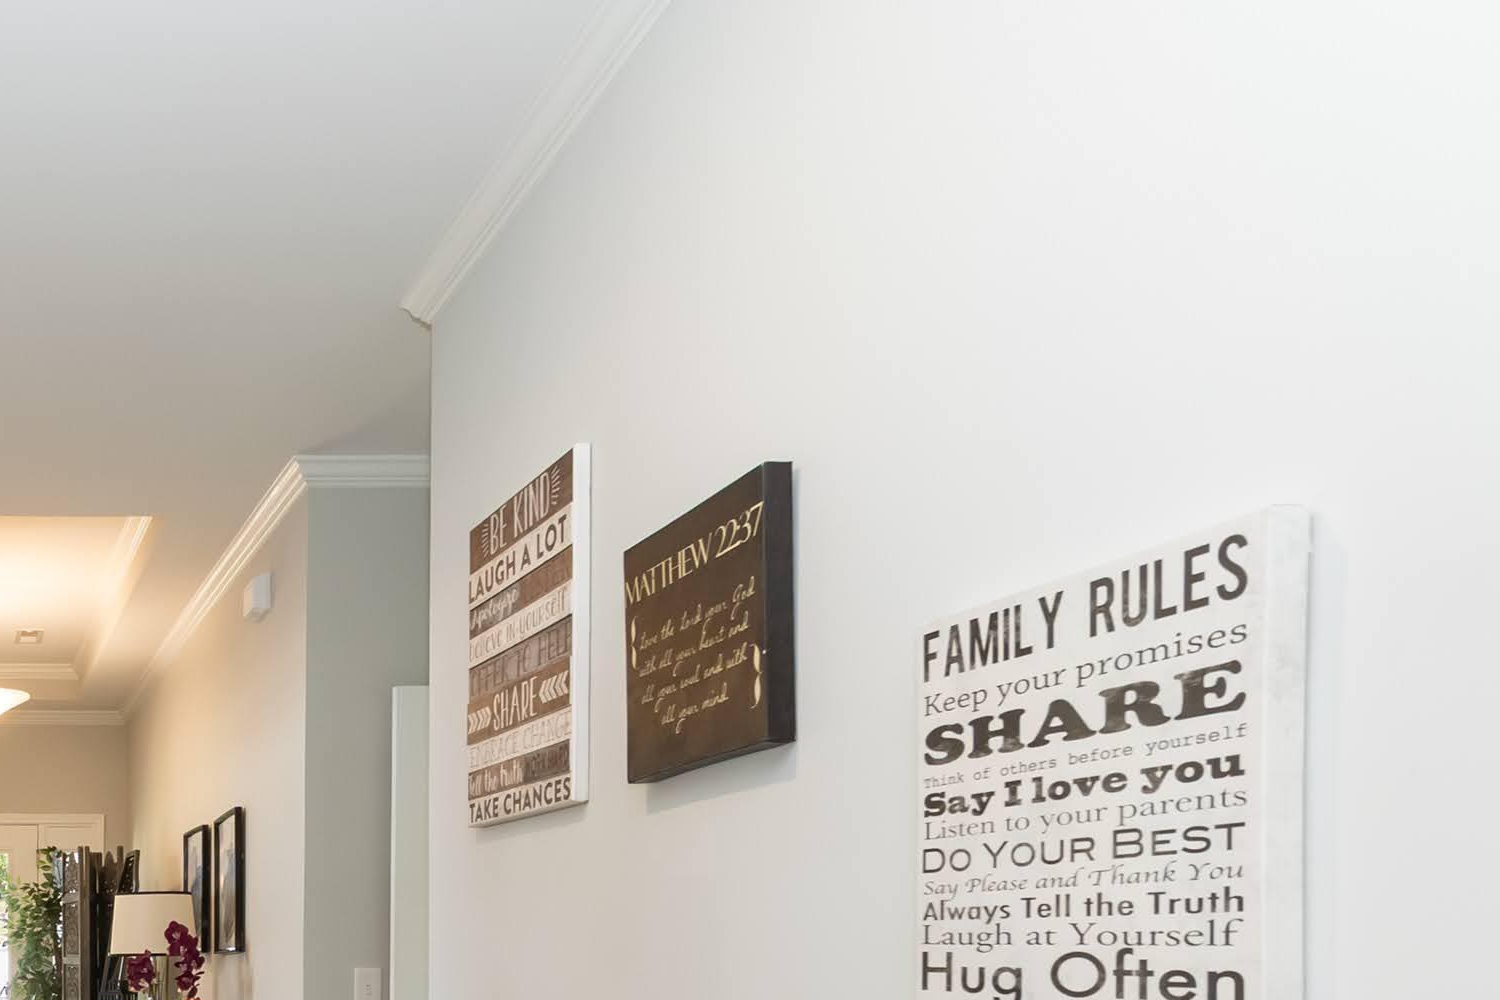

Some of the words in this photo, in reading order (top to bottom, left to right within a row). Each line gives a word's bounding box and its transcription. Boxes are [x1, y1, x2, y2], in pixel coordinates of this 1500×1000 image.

[490, 504, 507, 555] BE
[513, 472, 550, 538] KIND
[469, 551, 515, 603] LAUGH
[521, 544, 531, 570] A
[536, 514, 567, 560] LOT
[626, 532, 713, 604] MATTHEW
[923, 591, 1064, 683] FAMILY
[1089, 534, 1248, 637] RULES
[924, 685, 988, 716] Keep
[997, 669, 1065, 706] your
[1076, 623, 1248, 688] promises
[493, 676, 538, 731] SHARE
[924, 660, 1247, 766] SHARE
[924, 772, 964, 789] Think
[973, 768, 990, 780] of
[1000, 758, 1057, 776] others
[1069, 744, 1133, 766] before
[1145, 723, 1248, 756] yourself
[924, 791, 995, 817] Say
[1004, 780, 1022, 807] I
[1031, 771, 1128, 804] love
[1140, 754, 1245, 794] you
[470, 797, 499, 823] TAKE
[504, 777, 571, 815] CHANCES
[924, 820, 995, 840] Listen
[1005, 813, 1031, 832] to
[1040, 807, 1108, 836] your
[1118, 789, 1248, 827] parents
[923, 848, 972, 873] DO
[983, 837, 1096, 869] YOUR
[1113, 822, 1246, 859] BEST
[923, 881, 958, 899] Say
[964, 875, 1027, 894] Please
[1035, 872, 1079, 889] and
[1087, 861, 1176, 887] Thank
[1189, 863, 1243, 882] You
[923, 900, 1011, 924] Always
[1020, 894, 1071, 918] Tell
[1084, 893, 1134, 917] the
[1148, 886, 1244, 915] Truth
[922, 922, 1012, 953] Laugh
[1026, 926, 1056, 946] at
[1069, 919, 1244, 947] Yourself
